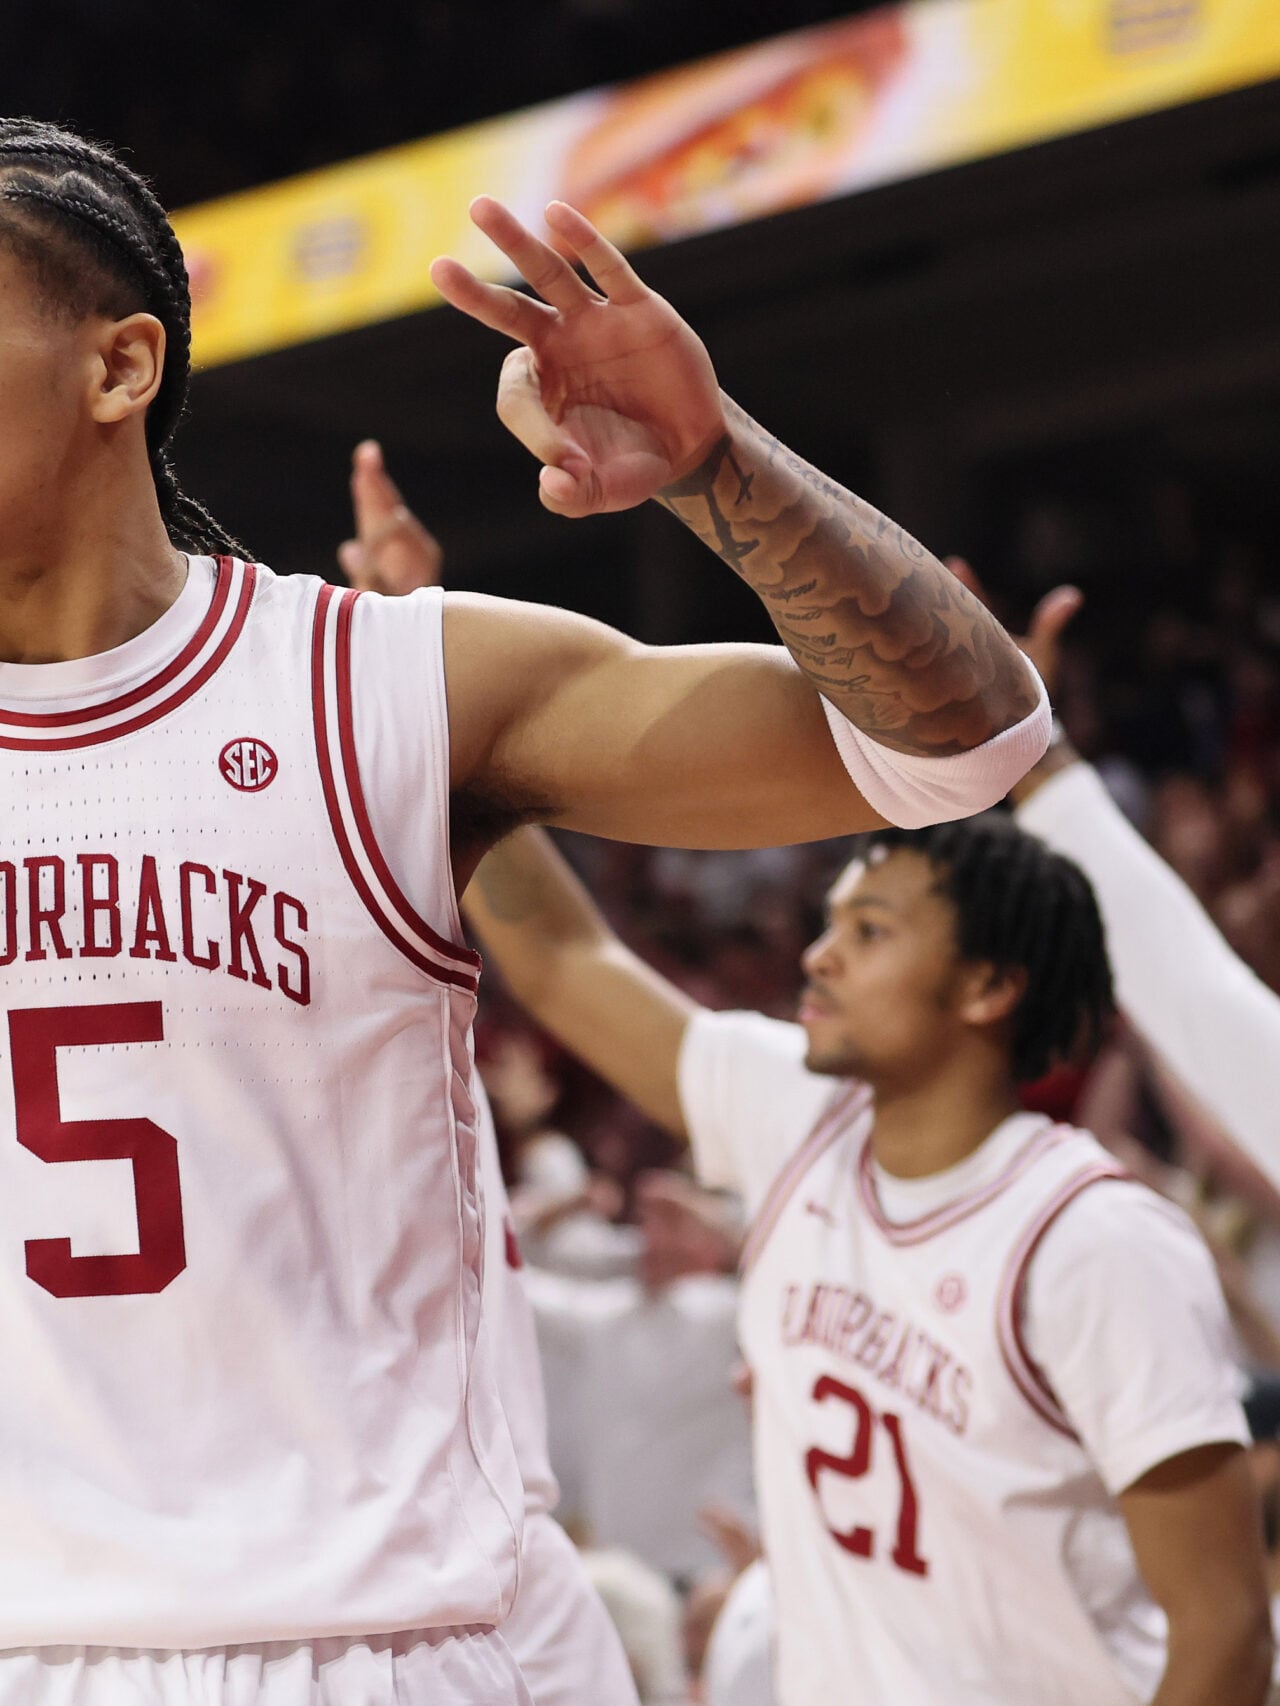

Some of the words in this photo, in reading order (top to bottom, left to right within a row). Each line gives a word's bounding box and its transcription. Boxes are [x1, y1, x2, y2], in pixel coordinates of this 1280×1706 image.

[223, 740, 273, 788] SEC
[7, 1000, 188, 1299] 5
[805, 1373, 930, 1580] 21
